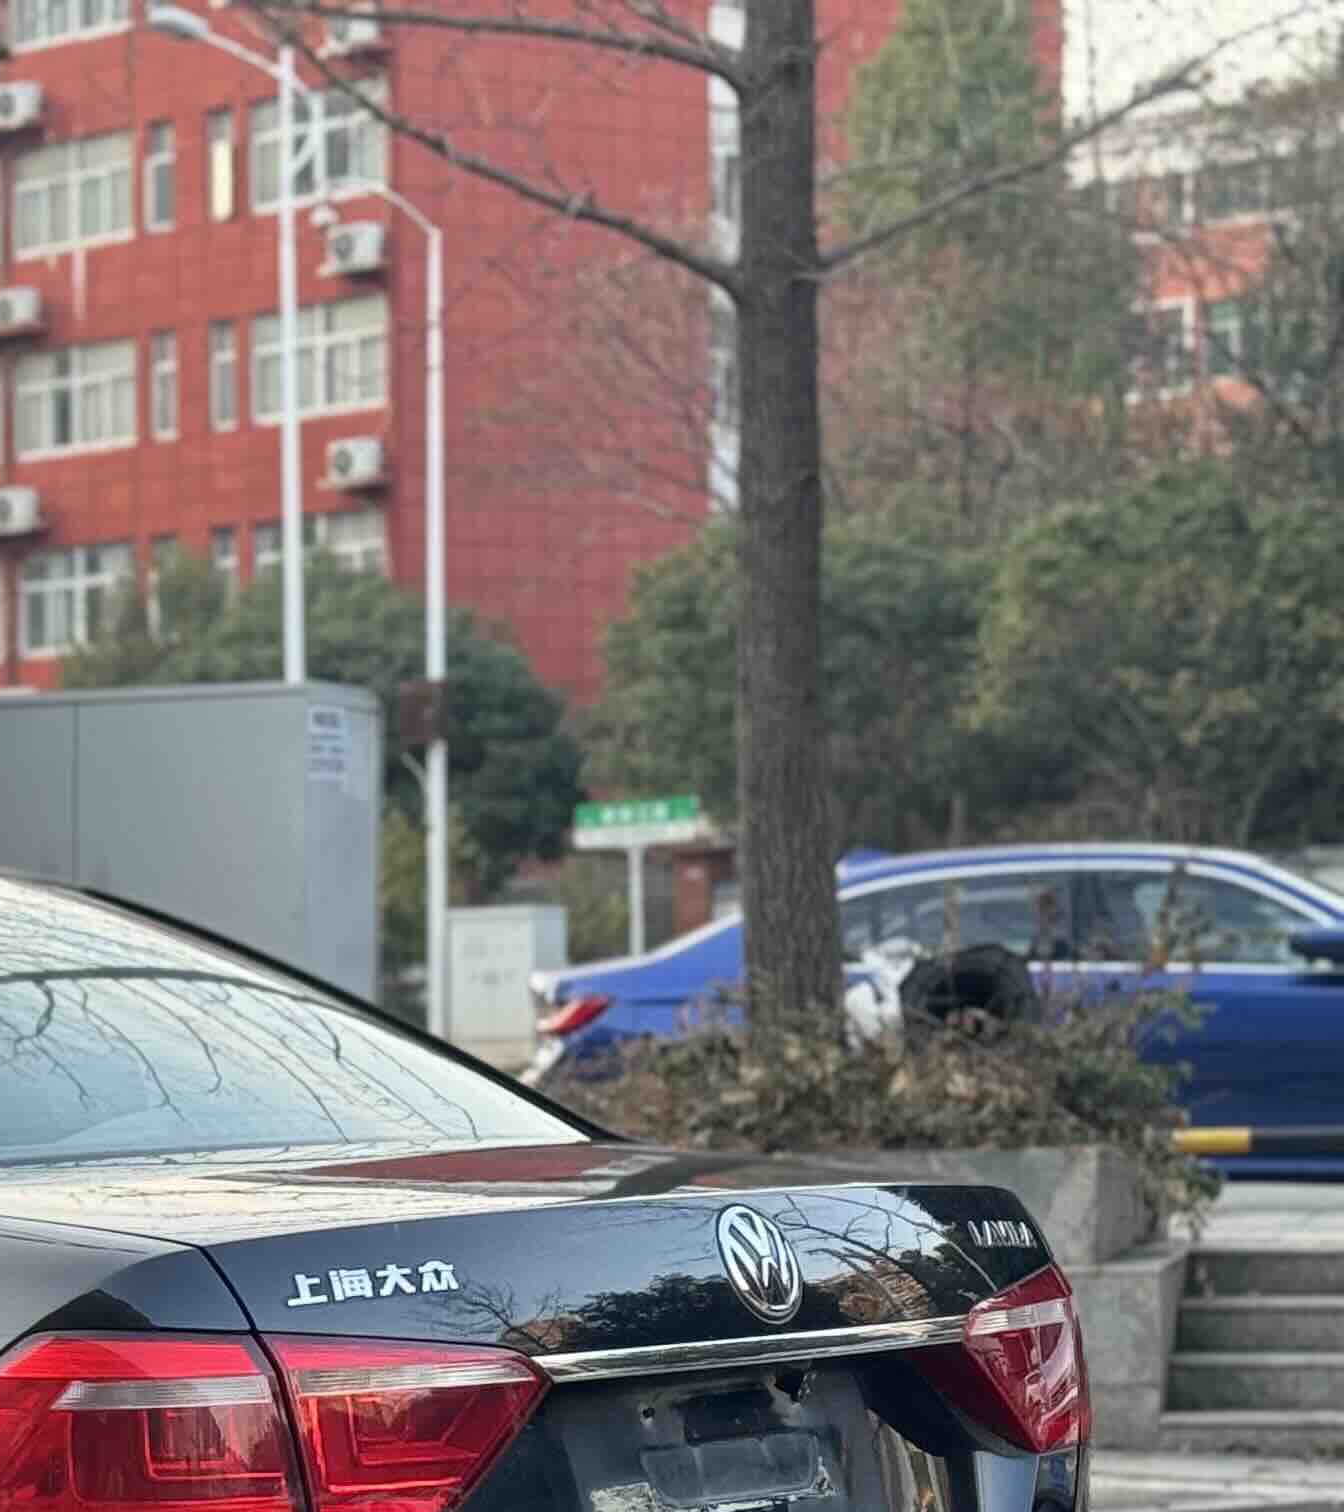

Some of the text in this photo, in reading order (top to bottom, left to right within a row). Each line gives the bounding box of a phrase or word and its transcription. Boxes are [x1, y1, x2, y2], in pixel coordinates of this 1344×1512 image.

[967, 1220, 1038, 1248] LAVIDA
[287, 1259, 459, 1306] 上海大众
